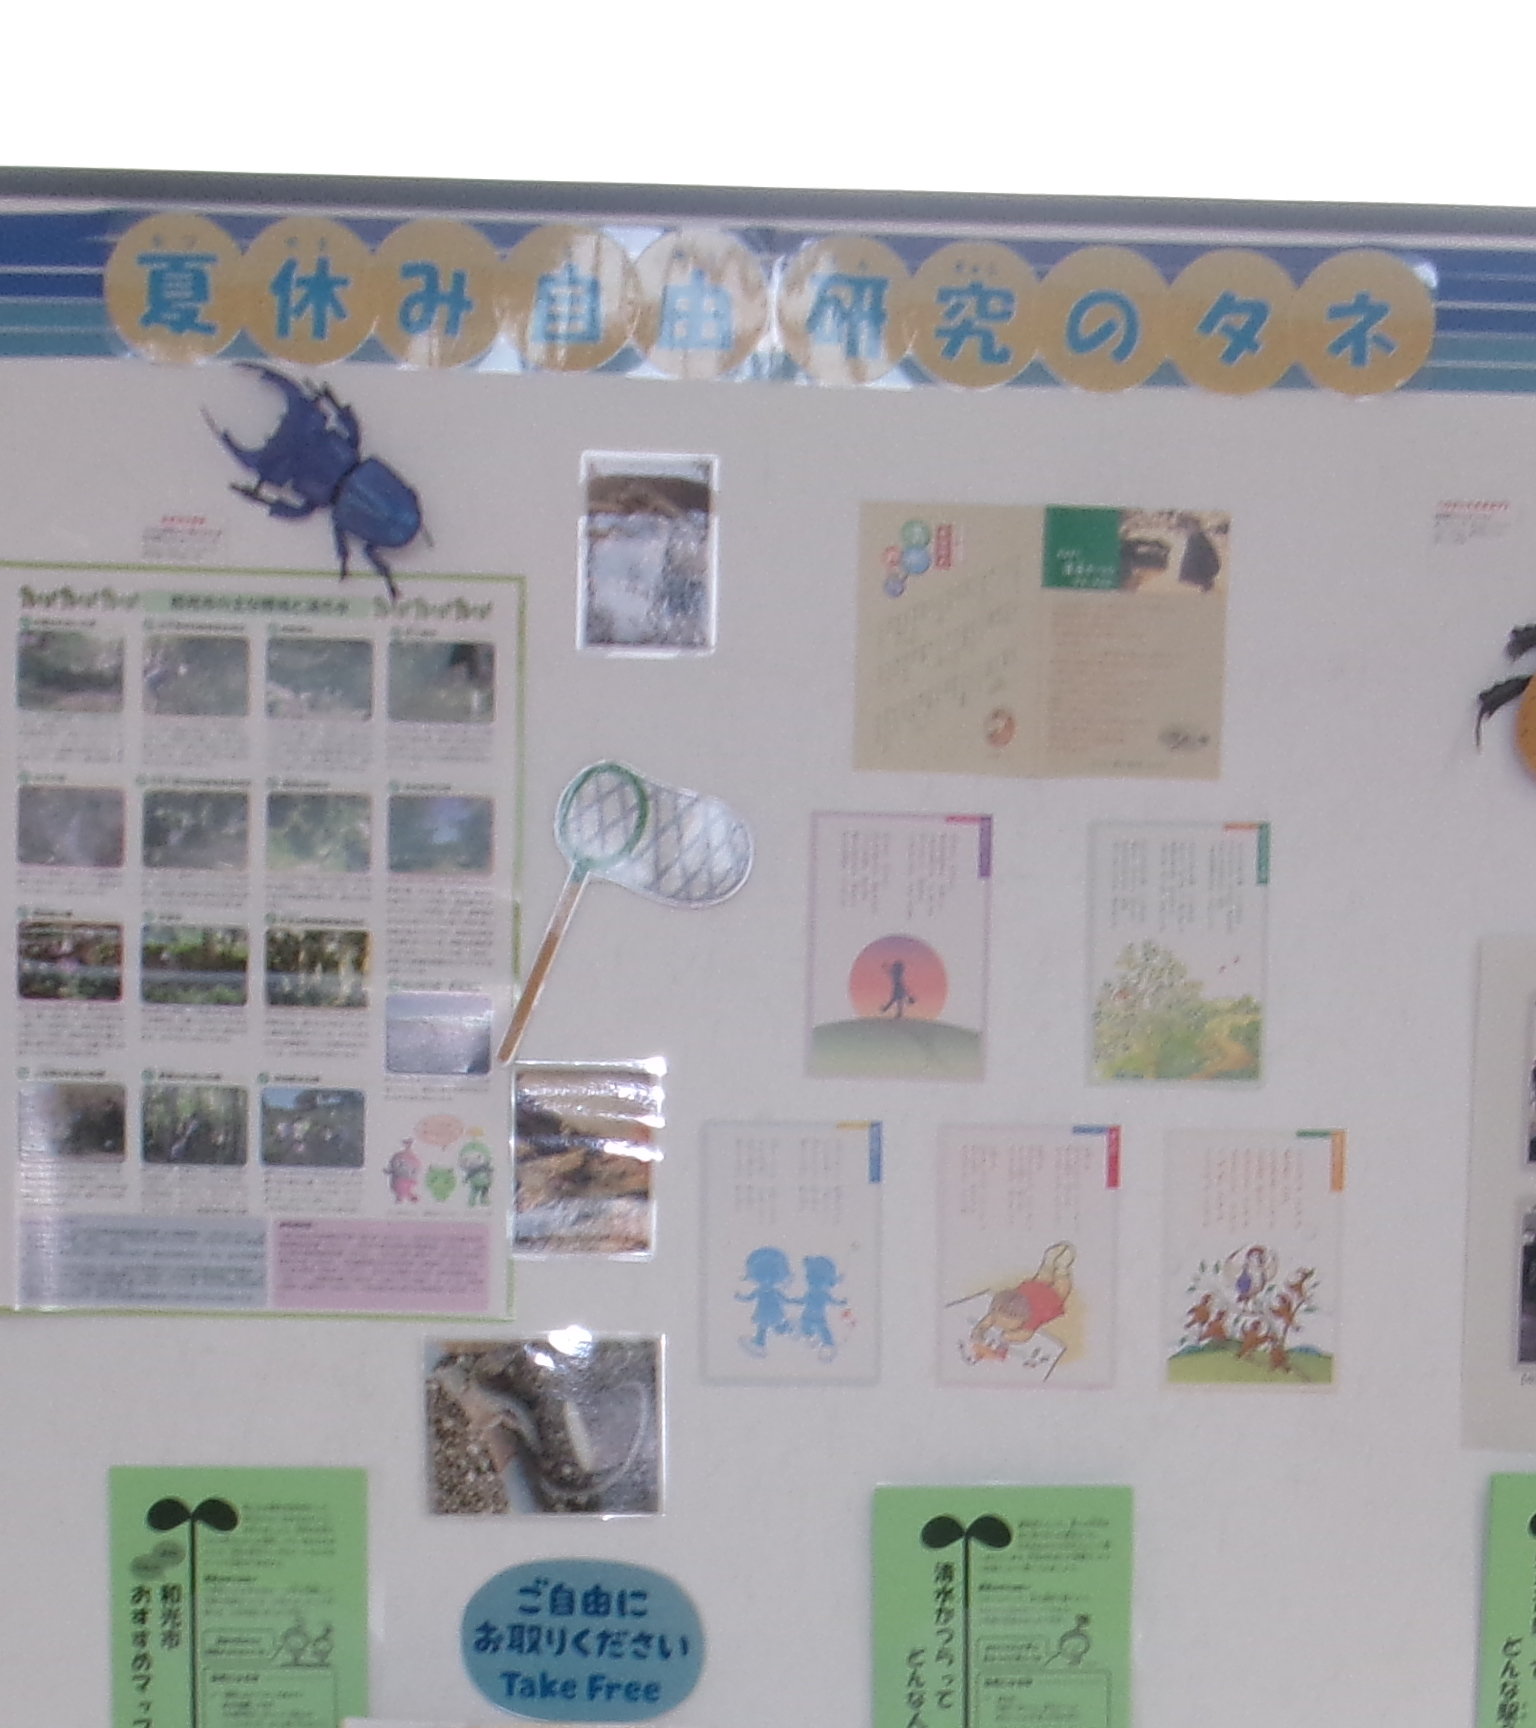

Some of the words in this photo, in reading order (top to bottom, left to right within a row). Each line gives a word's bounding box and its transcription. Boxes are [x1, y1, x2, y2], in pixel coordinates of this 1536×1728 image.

[137, 250, 1398, 368] 夏休み自由研究のタネ
[519, 1577, 648, 1617] ご自由に
[474, 1621, 690, 1659] お取りください
[501, 1671, 577, 1700] Take
[586, 1673, 661, 1702] Free
